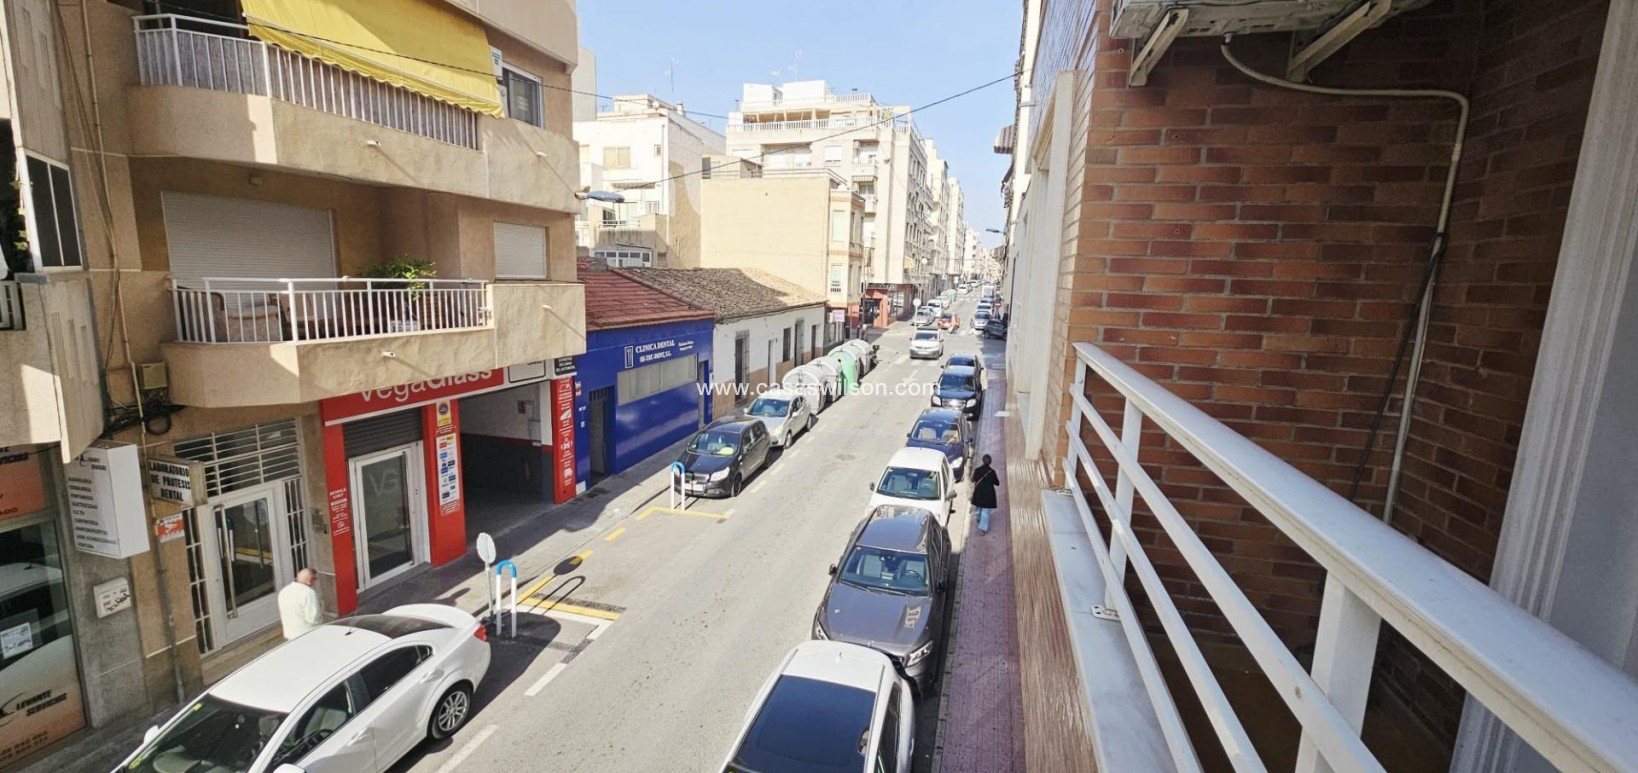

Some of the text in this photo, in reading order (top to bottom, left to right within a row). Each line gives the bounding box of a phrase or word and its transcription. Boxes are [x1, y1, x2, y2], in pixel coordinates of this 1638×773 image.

[635, 343, 657, 354] CLINICA
[658, 340, 675, 350] DENTAL
[150, 461, 190, 478] LABORATORIO
[151, 474, 191, 490] DE PROTESIS
[161, 488, 184, 502] DENTAL
